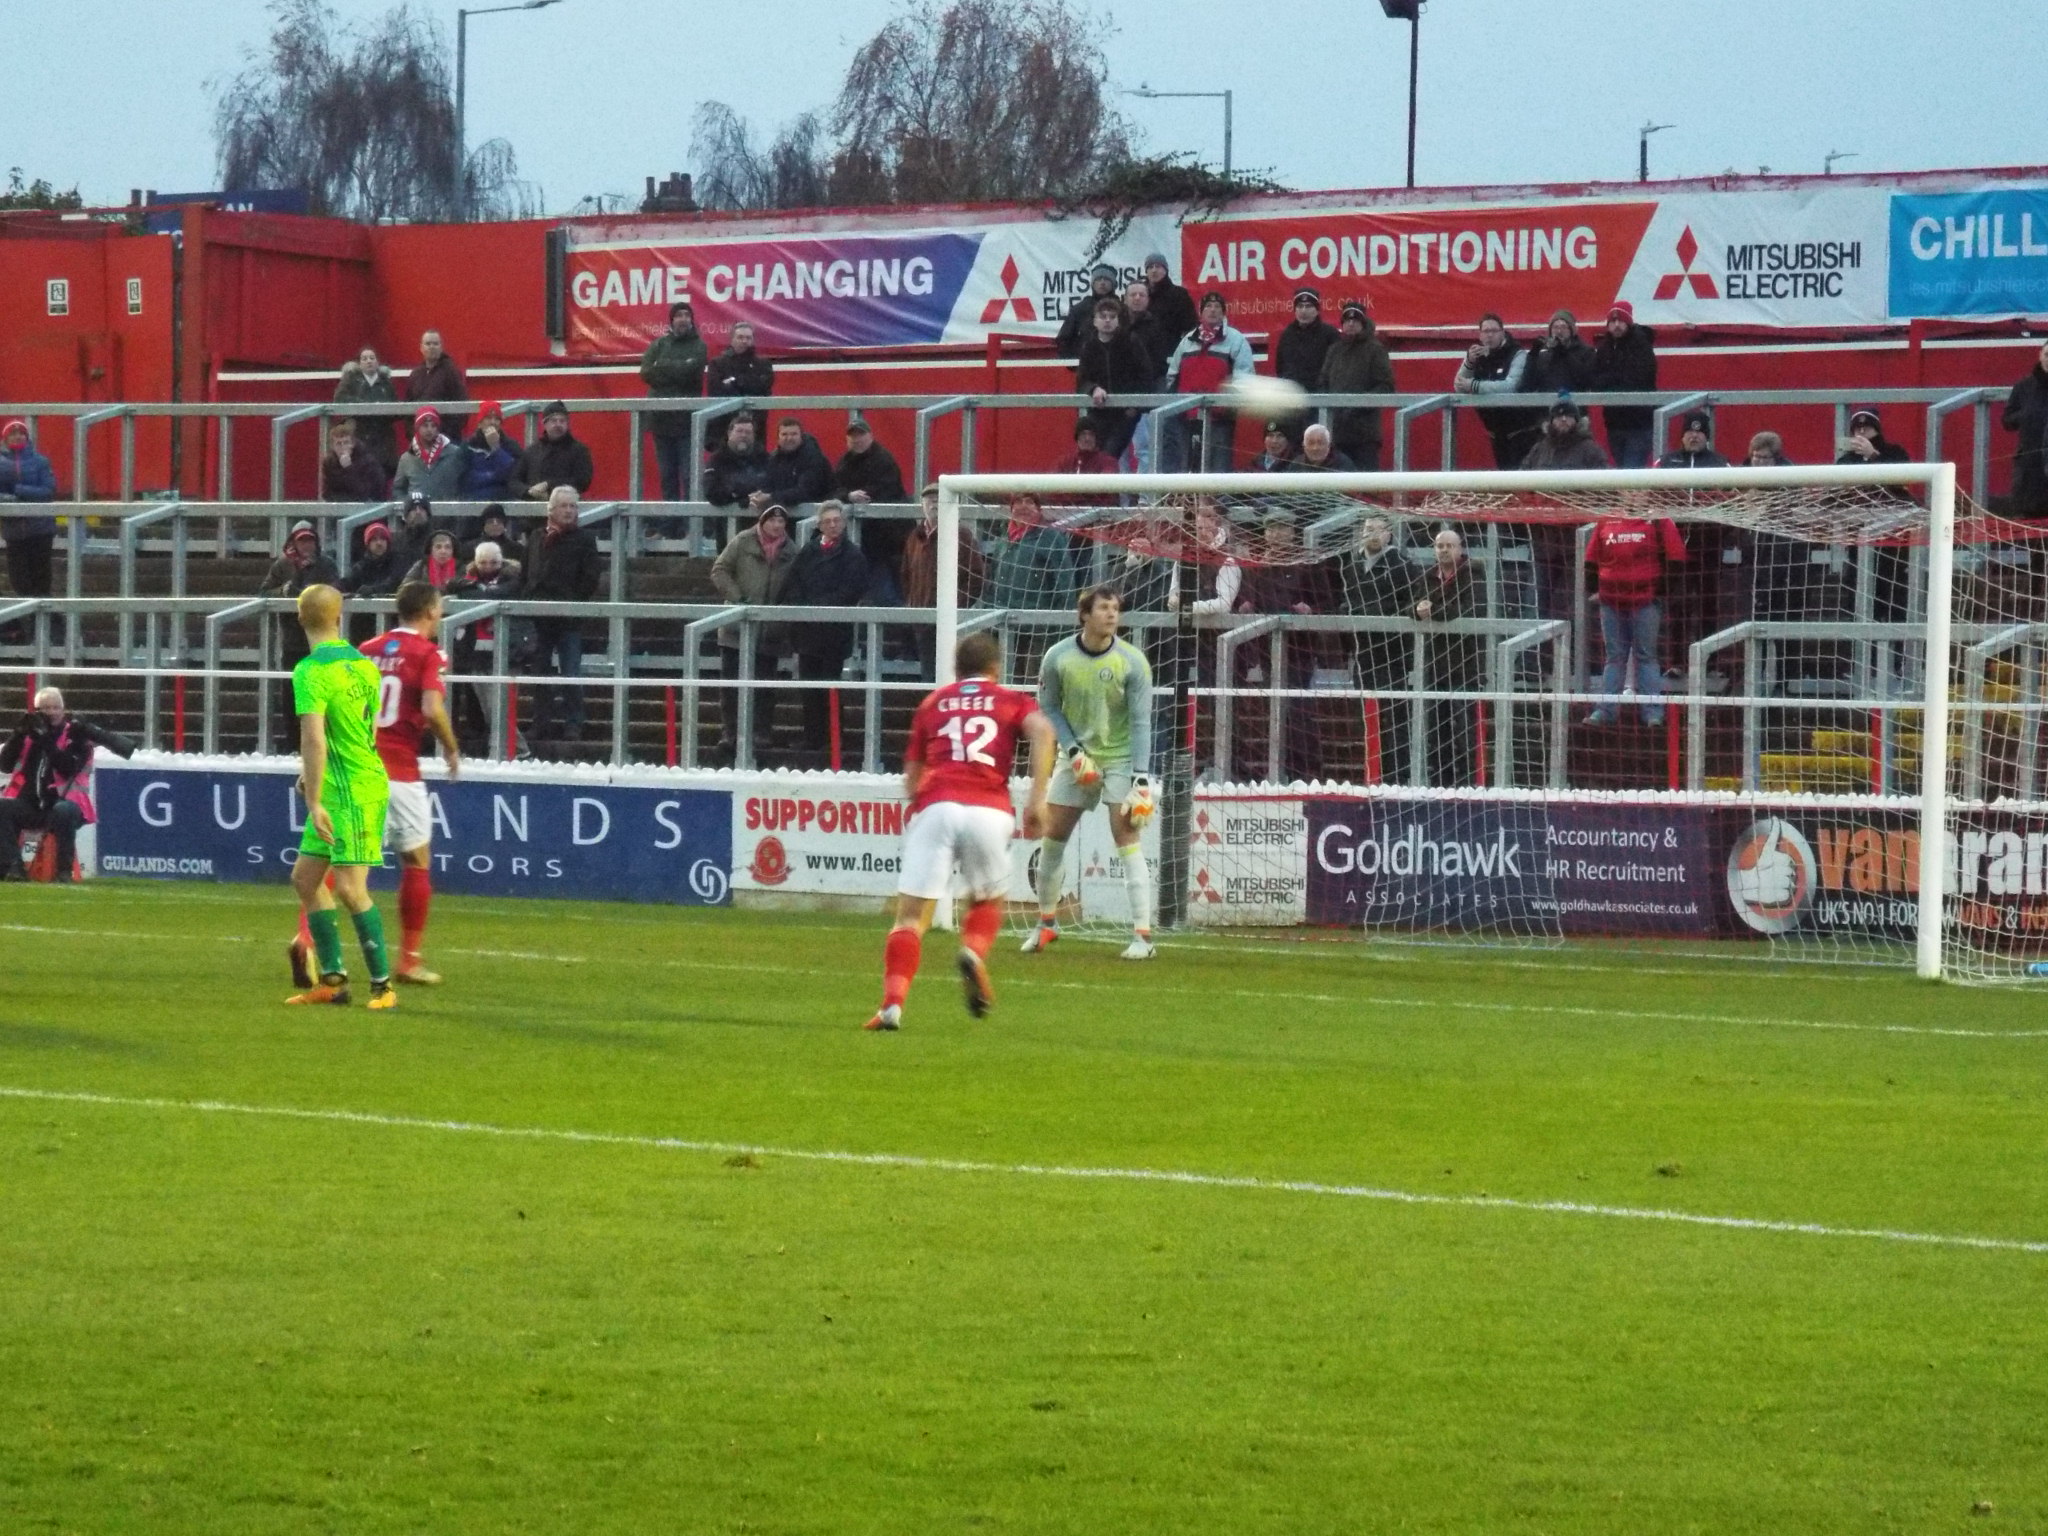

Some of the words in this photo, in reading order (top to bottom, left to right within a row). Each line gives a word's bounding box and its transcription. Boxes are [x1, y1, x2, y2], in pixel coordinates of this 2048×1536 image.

[1910, 213, 2048, 261] CHILL
[1197, 240, 1266, 284] AIR
[1280, 226, 1597, 280] CONDITIONING
[1726, 242, 1861, 271] MITSUBISHI
[571, 266, 691, 308] GAME
[705, 256, 933, 303] CHANGING
[1726, 271, 1844, 299] ELECTRIC
[937, 716, 999, 767] 12
[138, 782, 682, 849] GULANDS
[1226, 818, 1304, 832] MITSUBISHI
[1226, 832, 1294, 845] ELECTRIC
[1316, 823, 1521, 878] Goldhawk
[1545, 825, 1659, 852] Accountancy
[1663, 827, 1678, 848] &
[103, 855, 213, 874] GULLANDS.COM
[1545, 859, 1570, 879] HR
[1576, 860, 1686, 883] Recruitment
[1226, 877, 1304, 890] MITSUBISHI
[1226, 891, 1294, 904] ELECTRIC
[1346, 890, 1498, 908] ASSOCIATES
[1531, 899, 1699, 914] www.goldhawkassociates.co.uk
[1819, 900, 1850, 925] UK'S
[2005, 906, 2018, 929] &
